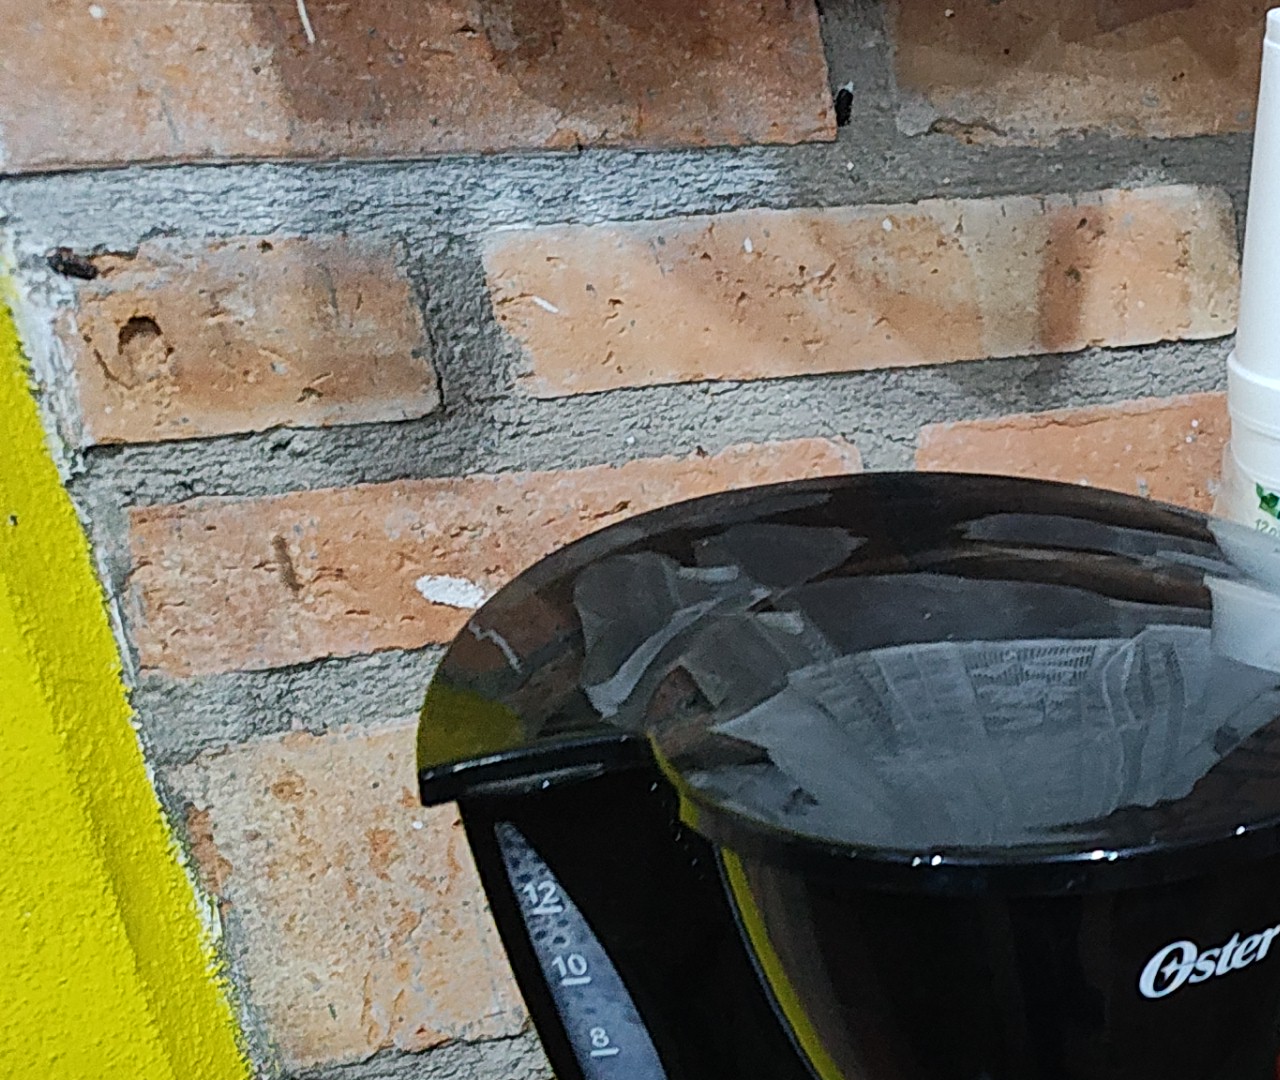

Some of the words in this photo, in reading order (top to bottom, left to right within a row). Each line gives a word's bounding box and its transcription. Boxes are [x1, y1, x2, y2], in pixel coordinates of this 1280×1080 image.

[523, 880, 560, 904] 12
[551, 952, 588, 977] 10
[590, 1026, 610, 1047] 8
